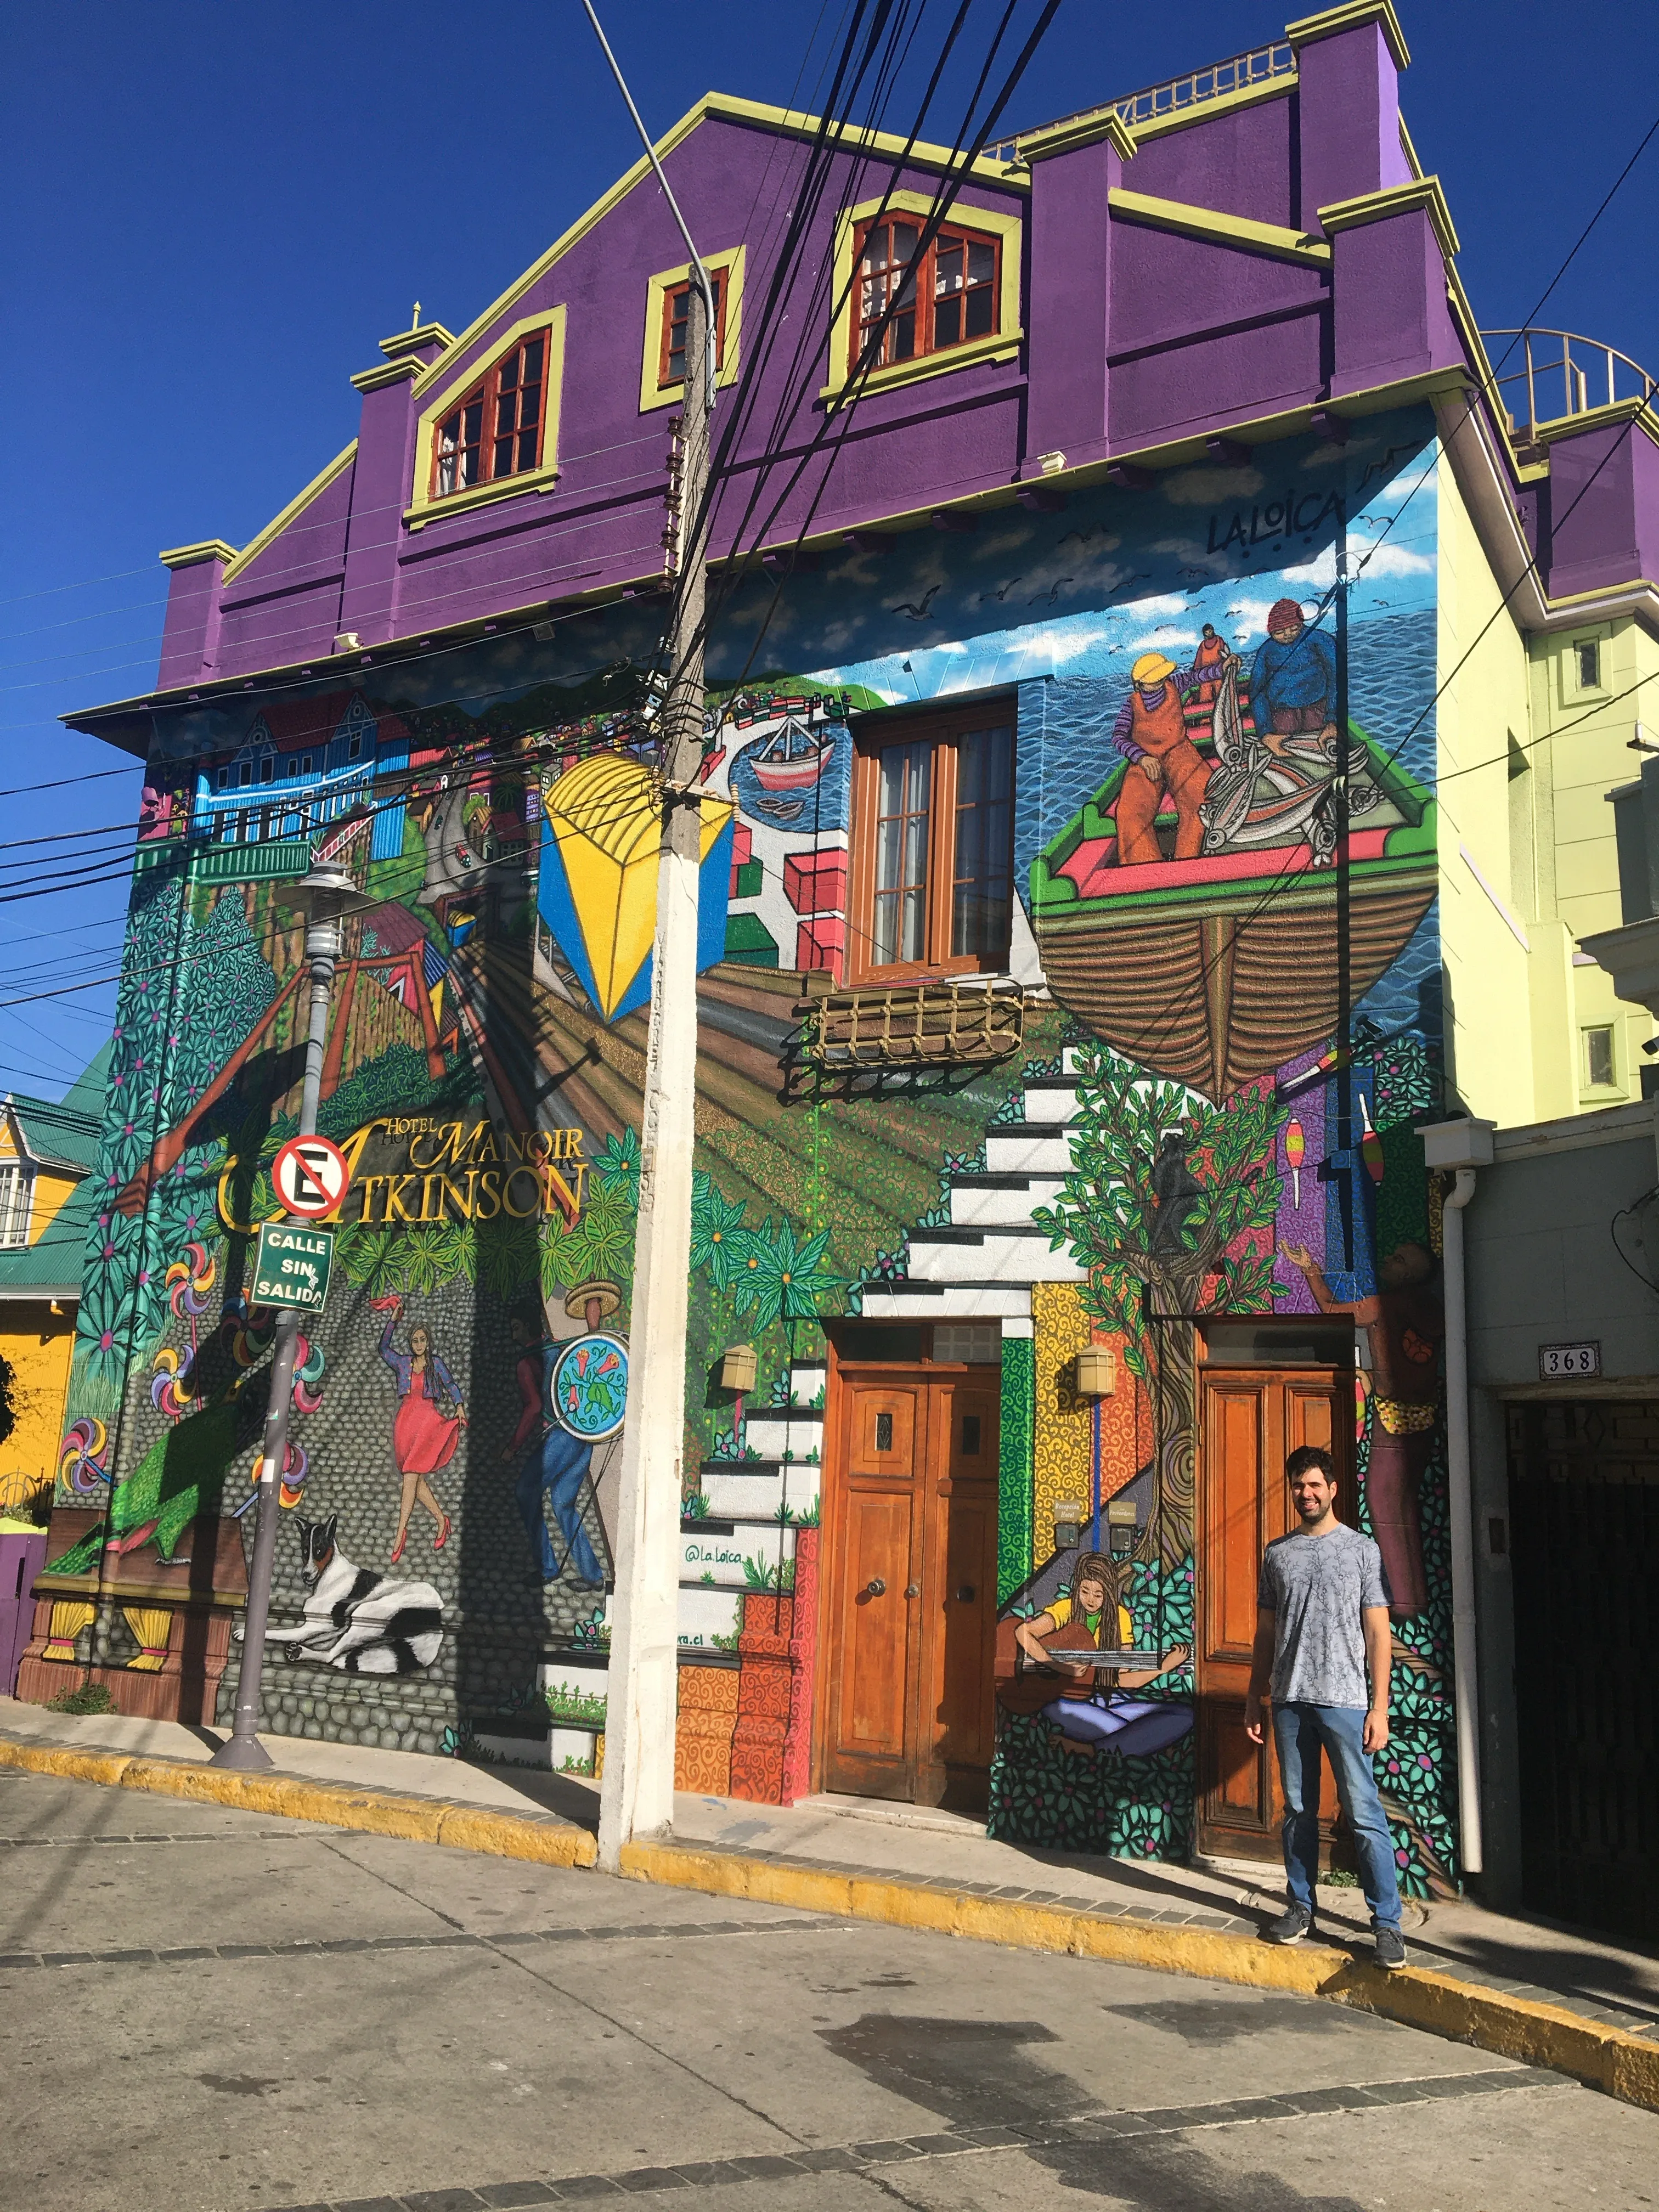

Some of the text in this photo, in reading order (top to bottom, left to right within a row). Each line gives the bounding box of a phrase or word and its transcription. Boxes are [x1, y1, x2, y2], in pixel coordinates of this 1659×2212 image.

[386, 1118, 438, 1135] HOTEL
[268, 1233, 326, 1255] CALLE
[281, 1259, 313, 1276] SIN
[257, 1281, 322, 1304] SALIDA
[1549, 1351, 1589, 1372] 368
